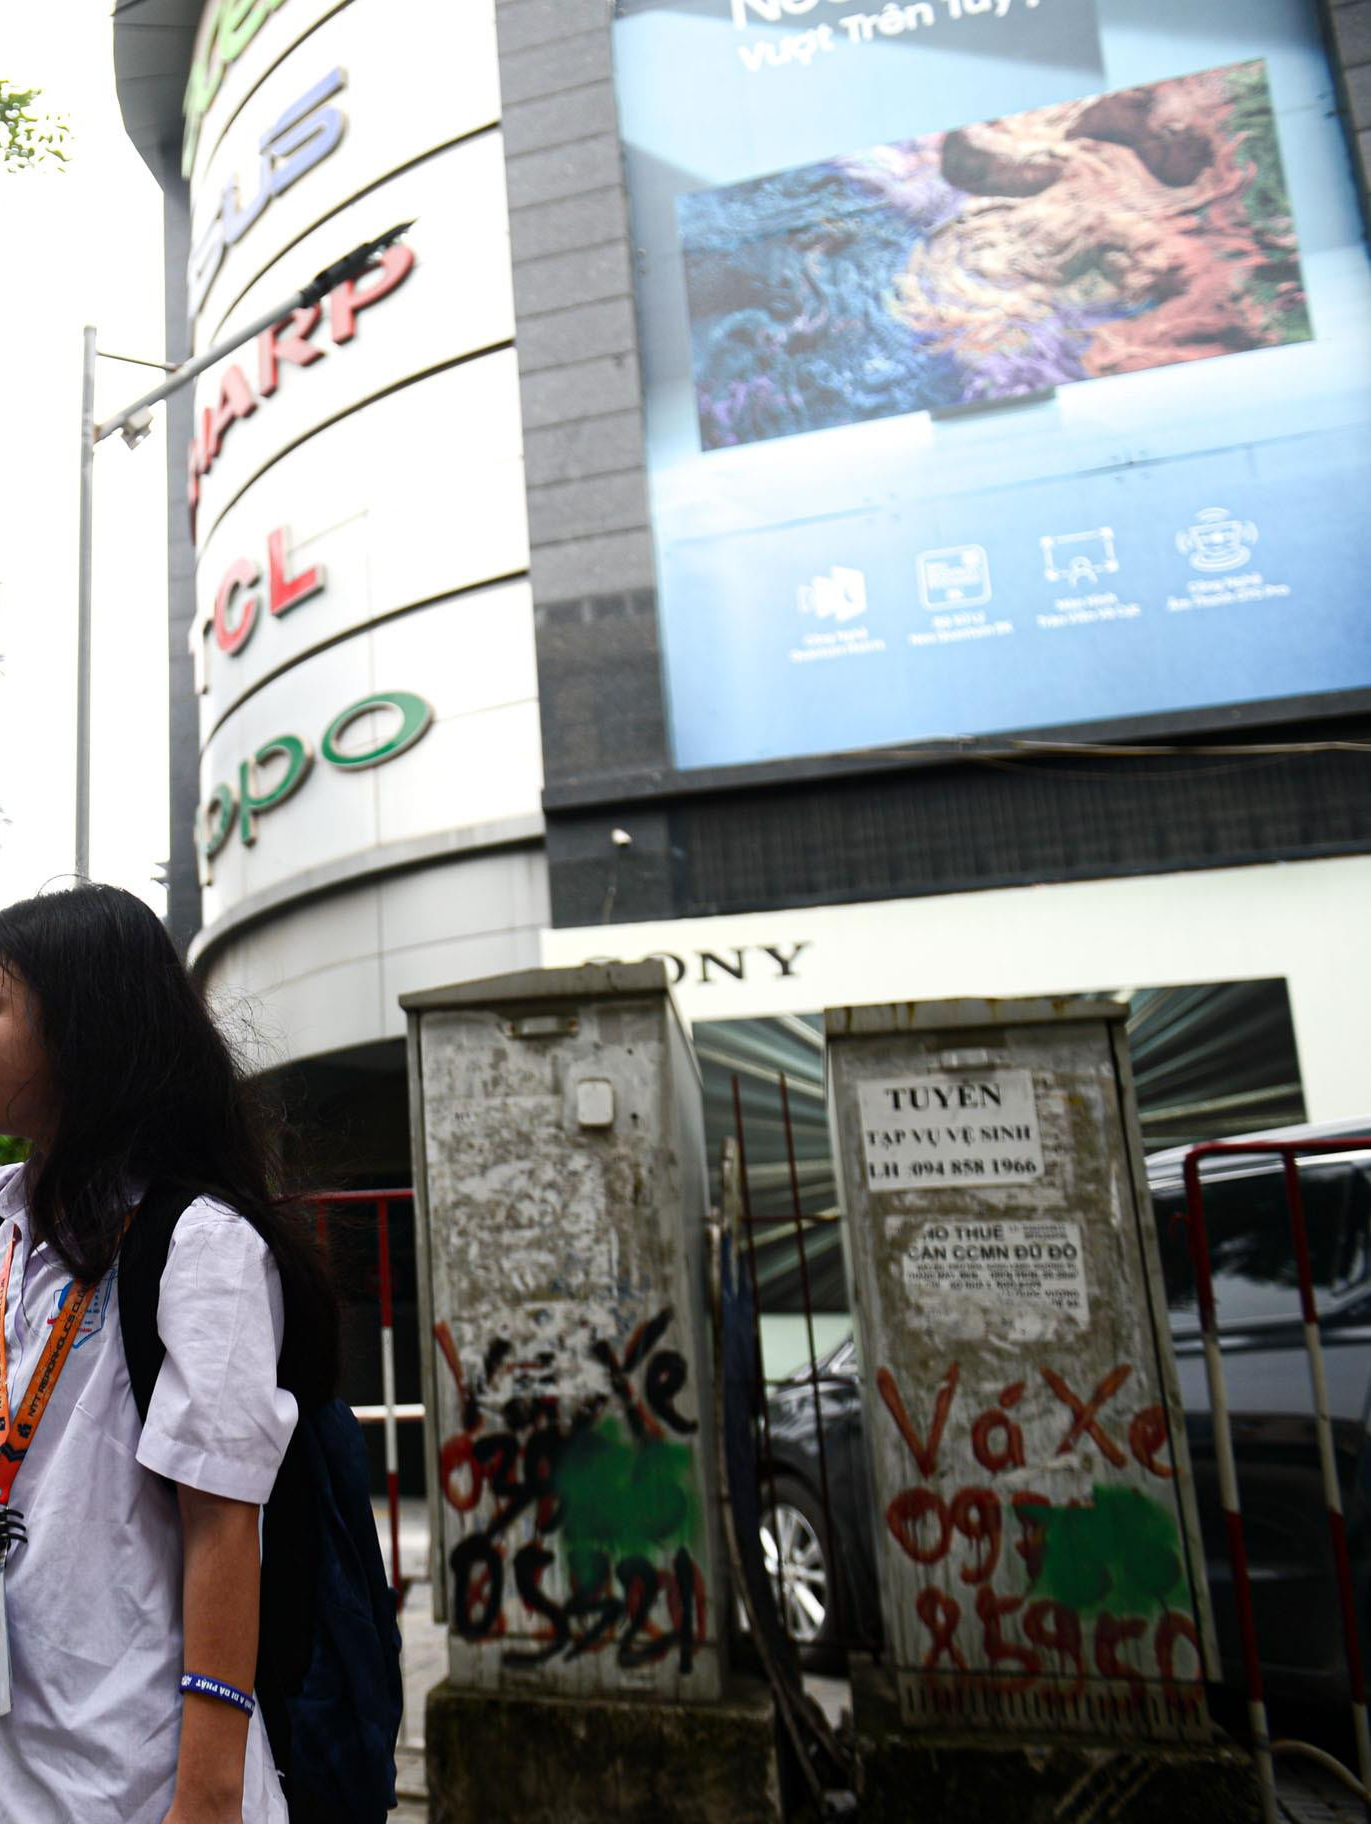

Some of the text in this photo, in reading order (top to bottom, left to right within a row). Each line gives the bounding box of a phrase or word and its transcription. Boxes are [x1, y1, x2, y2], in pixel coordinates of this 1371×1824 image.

[839, 2, 935, 44] Trên
[615, 939, 811, 984] ONY
[911, 1126, 943, 1148] VỤ
[980, 1124, 1032, 1142] SINH
[991, 1157, 1037, 1175] 1966
[1039, 1363, 1182, 1479] Xe
